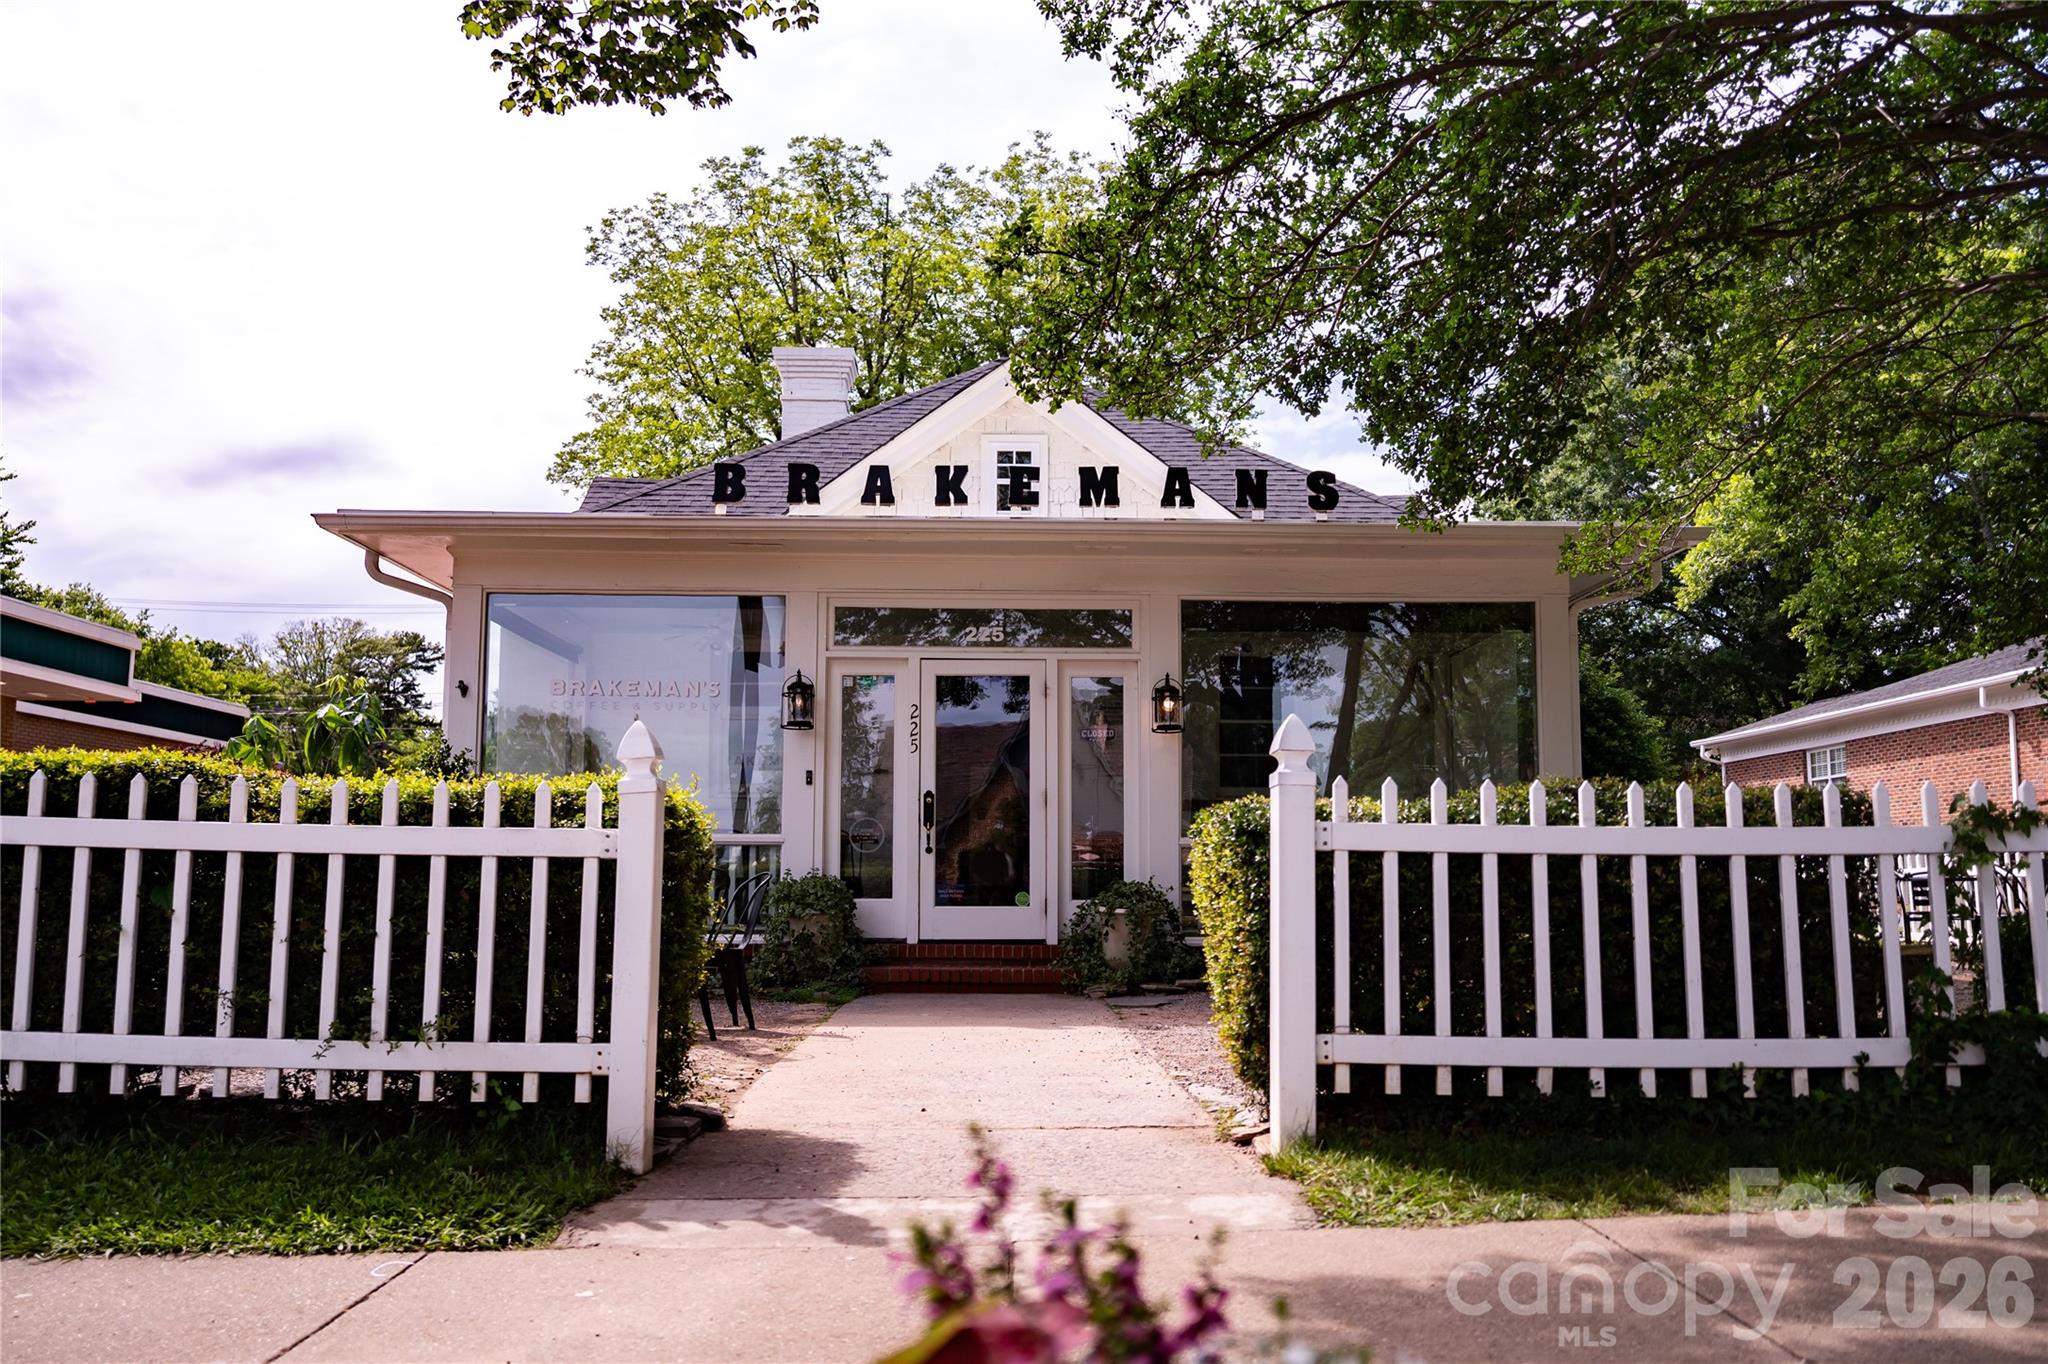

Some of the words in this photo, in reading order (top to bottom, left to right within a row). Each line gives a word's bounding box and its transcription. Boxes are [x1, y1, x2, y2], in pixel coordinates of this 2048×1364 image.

[712, 462, 1339, 511] BRAKEMANS
[965, 626, 1005, 642] 225
[551, 679, 721, 698] BRAKEMAN'S
[551, 701, 623, 711] COFFEE
[633, 701, 641, 711] &
[655, 702, 721, 711] SUPPLY
[910, 703, 920, 754] 225
[1081, 729, 1115, 738] CLOSED
